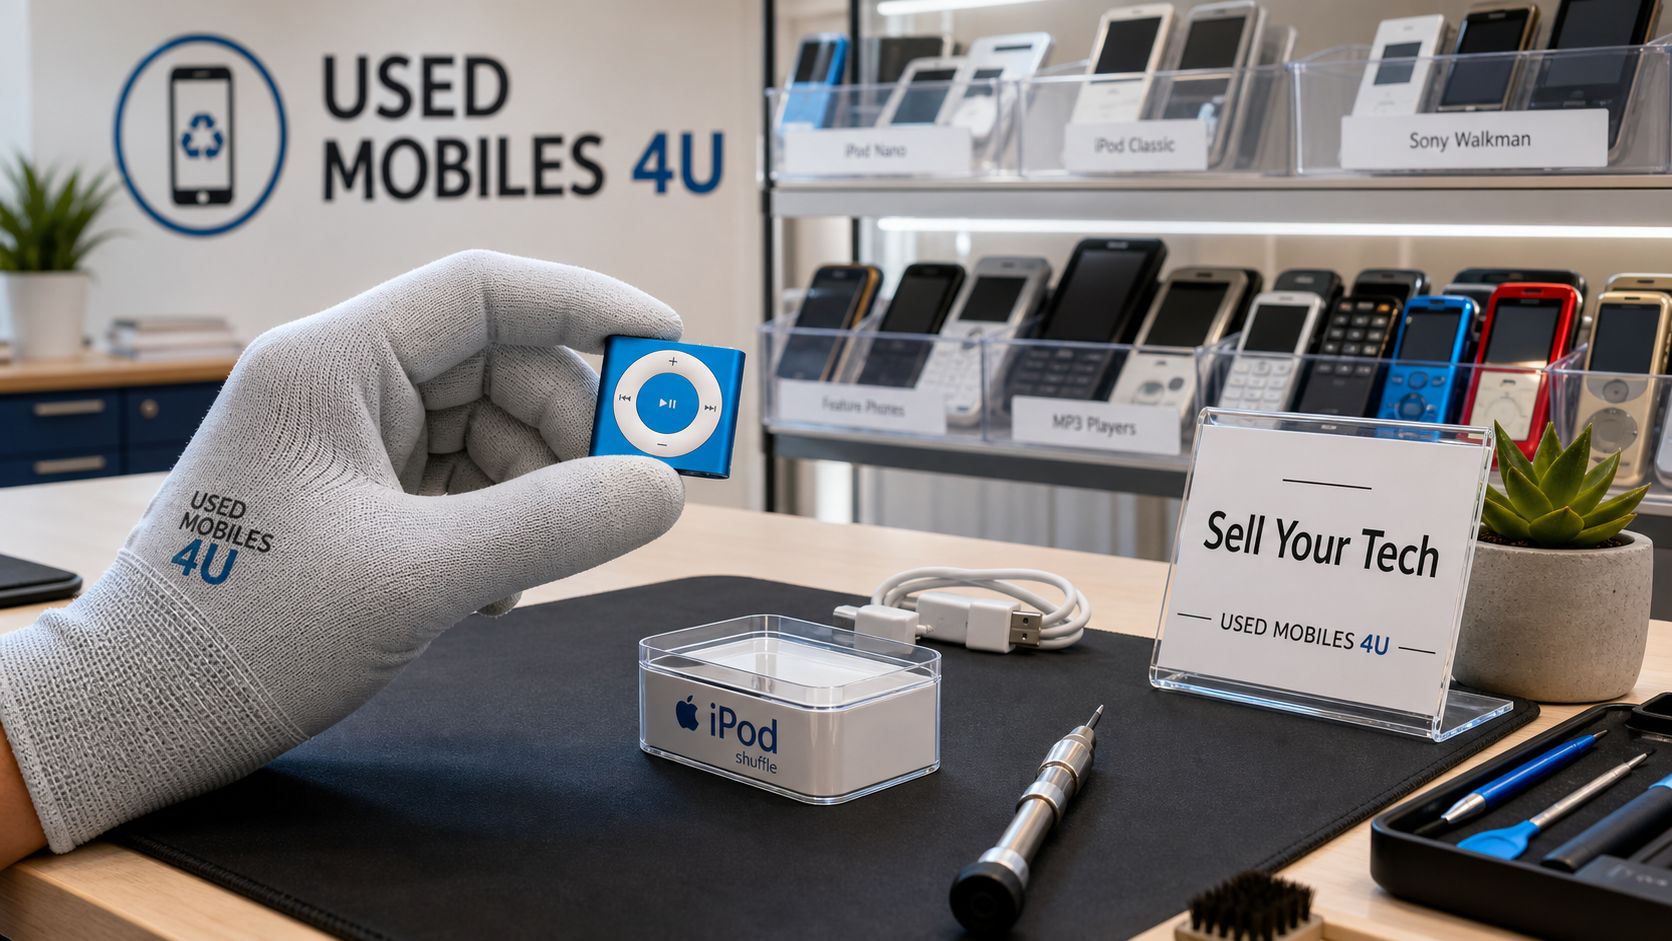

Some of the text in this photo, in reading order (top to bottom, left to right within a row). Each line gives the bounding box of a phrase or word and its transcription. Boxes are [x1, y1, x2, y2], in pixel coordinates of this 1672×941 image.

[322, 55, 510, 121] USED
[1094, 136, 1176, 154] iPod Classic
[1409, 129, 1532, 153] Sony Walkman
[323, 132, 725, 202] MOBILES 4U
[1052, 414, 1137, 437] MP3 Players
[191, 491, 247, 519] USED
[178, 511, 275, 553] MOBILES
[1203, 510, 1440, 578] Sell Your Tech
[171, 538, 239, 586] 4U
[1220, 612, 1390, 656] USED MOBILES 4U
[709, 702, 778, 755] iPod
[735, 751, 778, 775] shuffle
